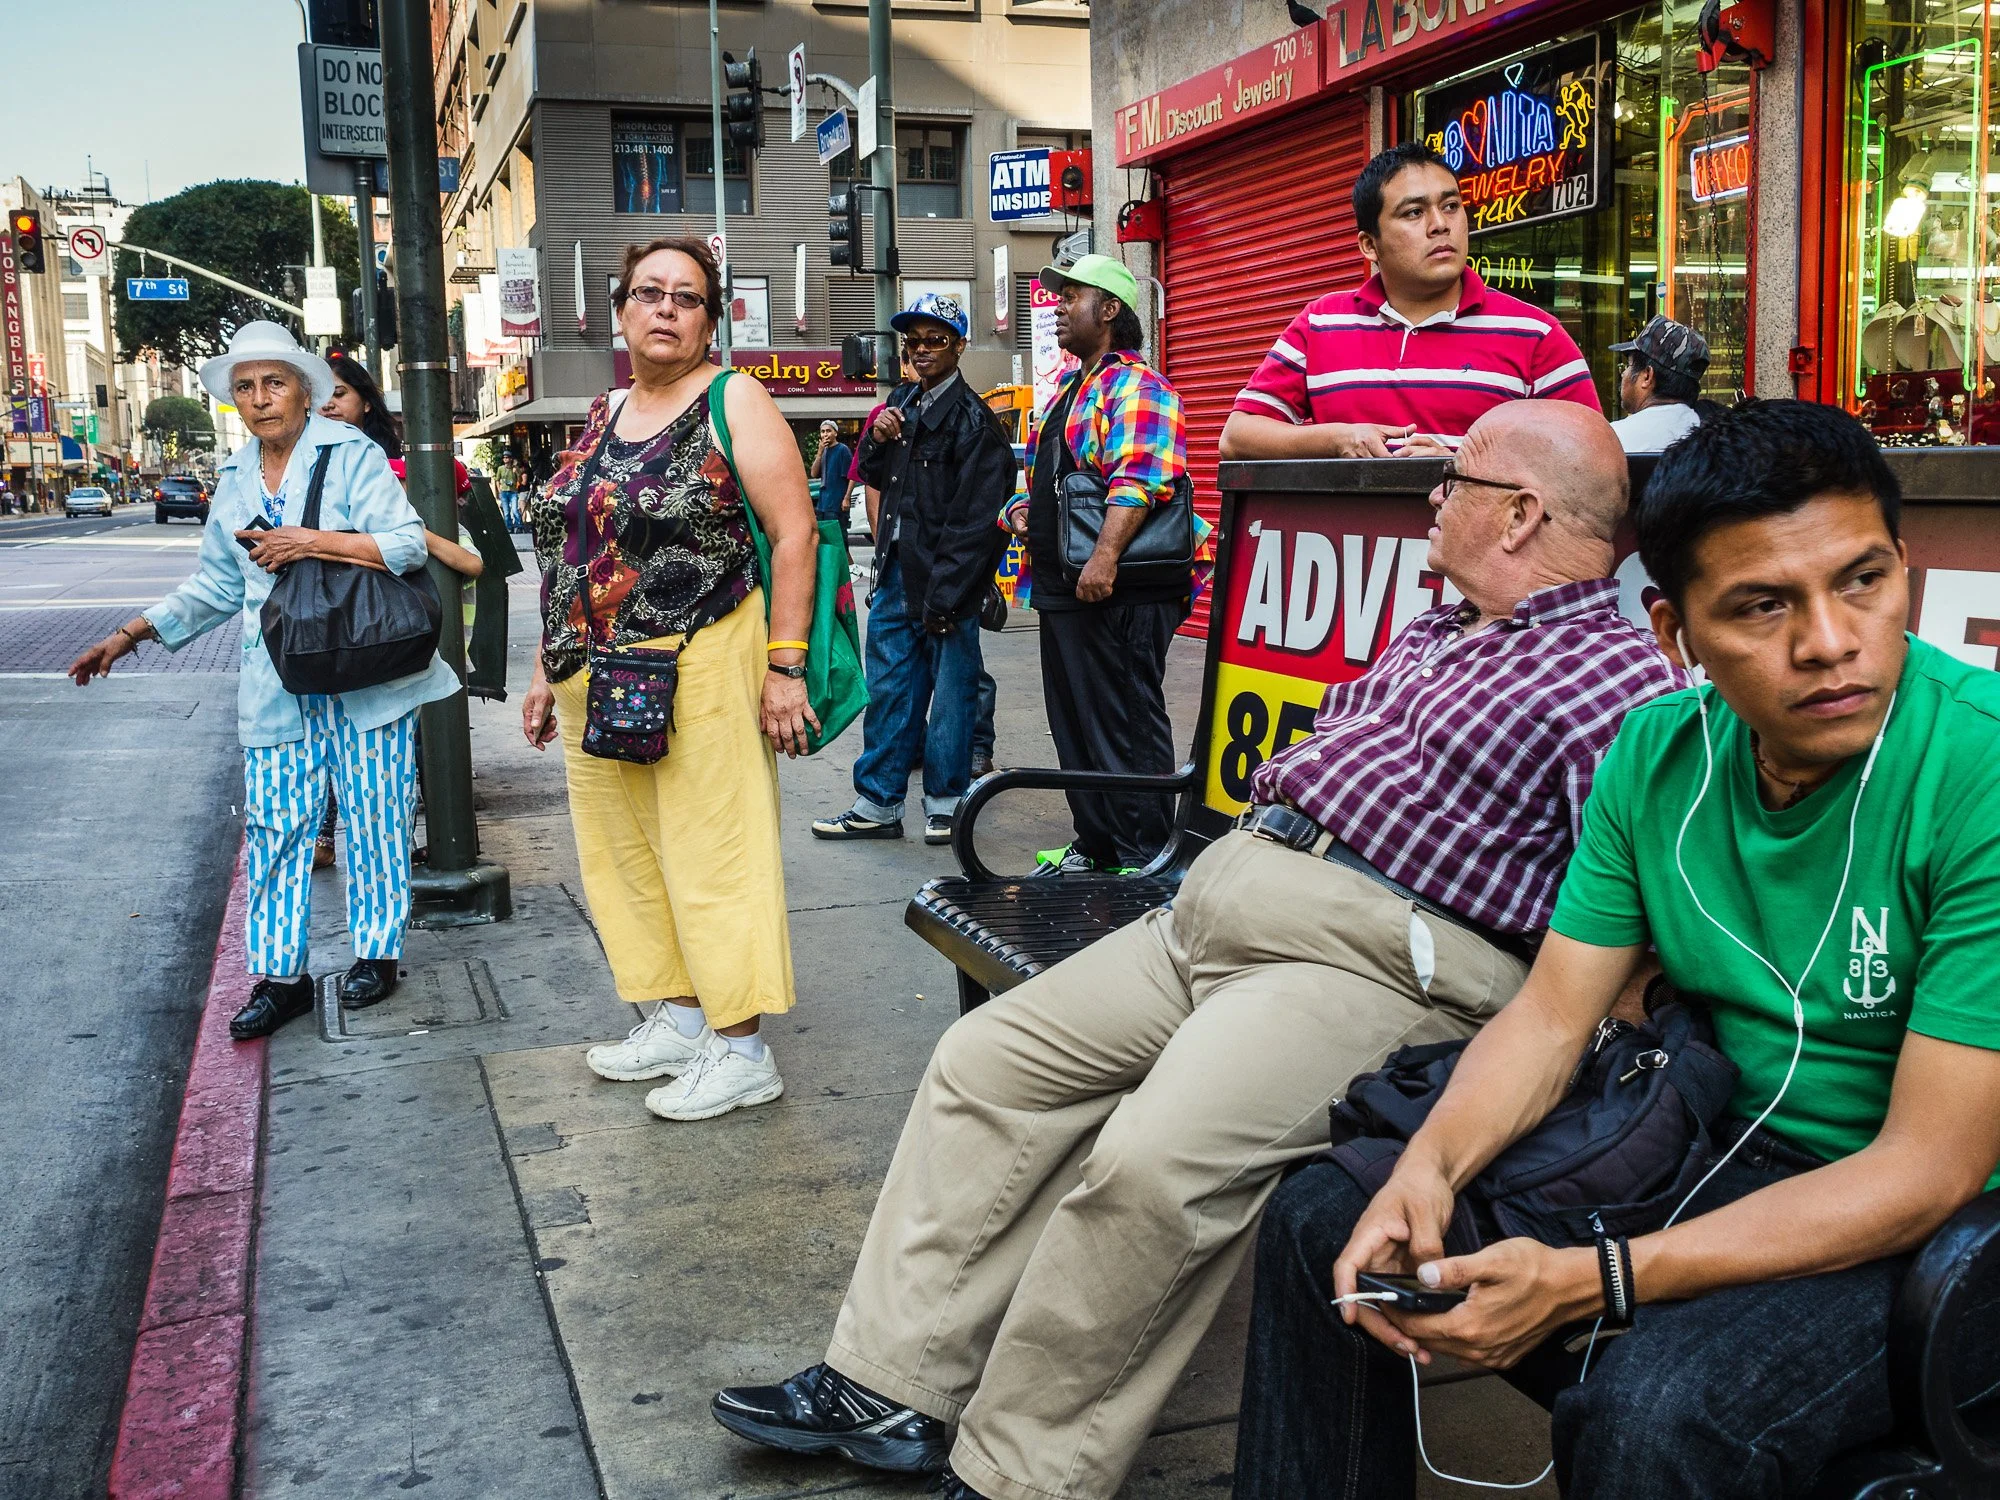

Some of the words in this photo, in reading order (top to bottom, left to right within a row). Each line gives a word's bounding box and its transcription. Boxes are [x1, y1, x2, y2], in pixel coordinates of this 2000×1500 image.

[1339, 0, 1386, 68] LA
[1273, 37, 1297, 67] 700
[322, 58, 350, 83] DO
[356, 61, 383, 85] NO
[324, 91, 385, 117] BLOC
[1125, 96, 1165, 156] F.M.
[1165, 92, 1223, 140] Discount
[1232, 67, 1294, 113] Jewelry
[321, 123, 386, 142] INTERSECTI
[612, 122, 673, 132] CHIROPRACTOR
[819, 121, 846, 152] Broadway
[614, 144, 674, 155] 213.481.1400
[438, 159, 455, 177] St
[991, 158, 1051, 190] ATM
[1458, 151, 1566, 207] EWELRY
[992, 191, 1052, 212] INSIDE
[1554, 175, 1588, 211] 702
[1473, 190, 1529, 230] 14K
[1, 241, 16, 284] LOS
[131, 281, 157, 298] 7th
[168, 283, 185, 295] St
[1033, 288, 1062, 305] GO
[730, 354, 810, 385] welry
[816, 361, 841, 379] &
[1237, 529, 1466, 662] ADVE
[1843, 1010, 1897, 1020] NAUTICA
